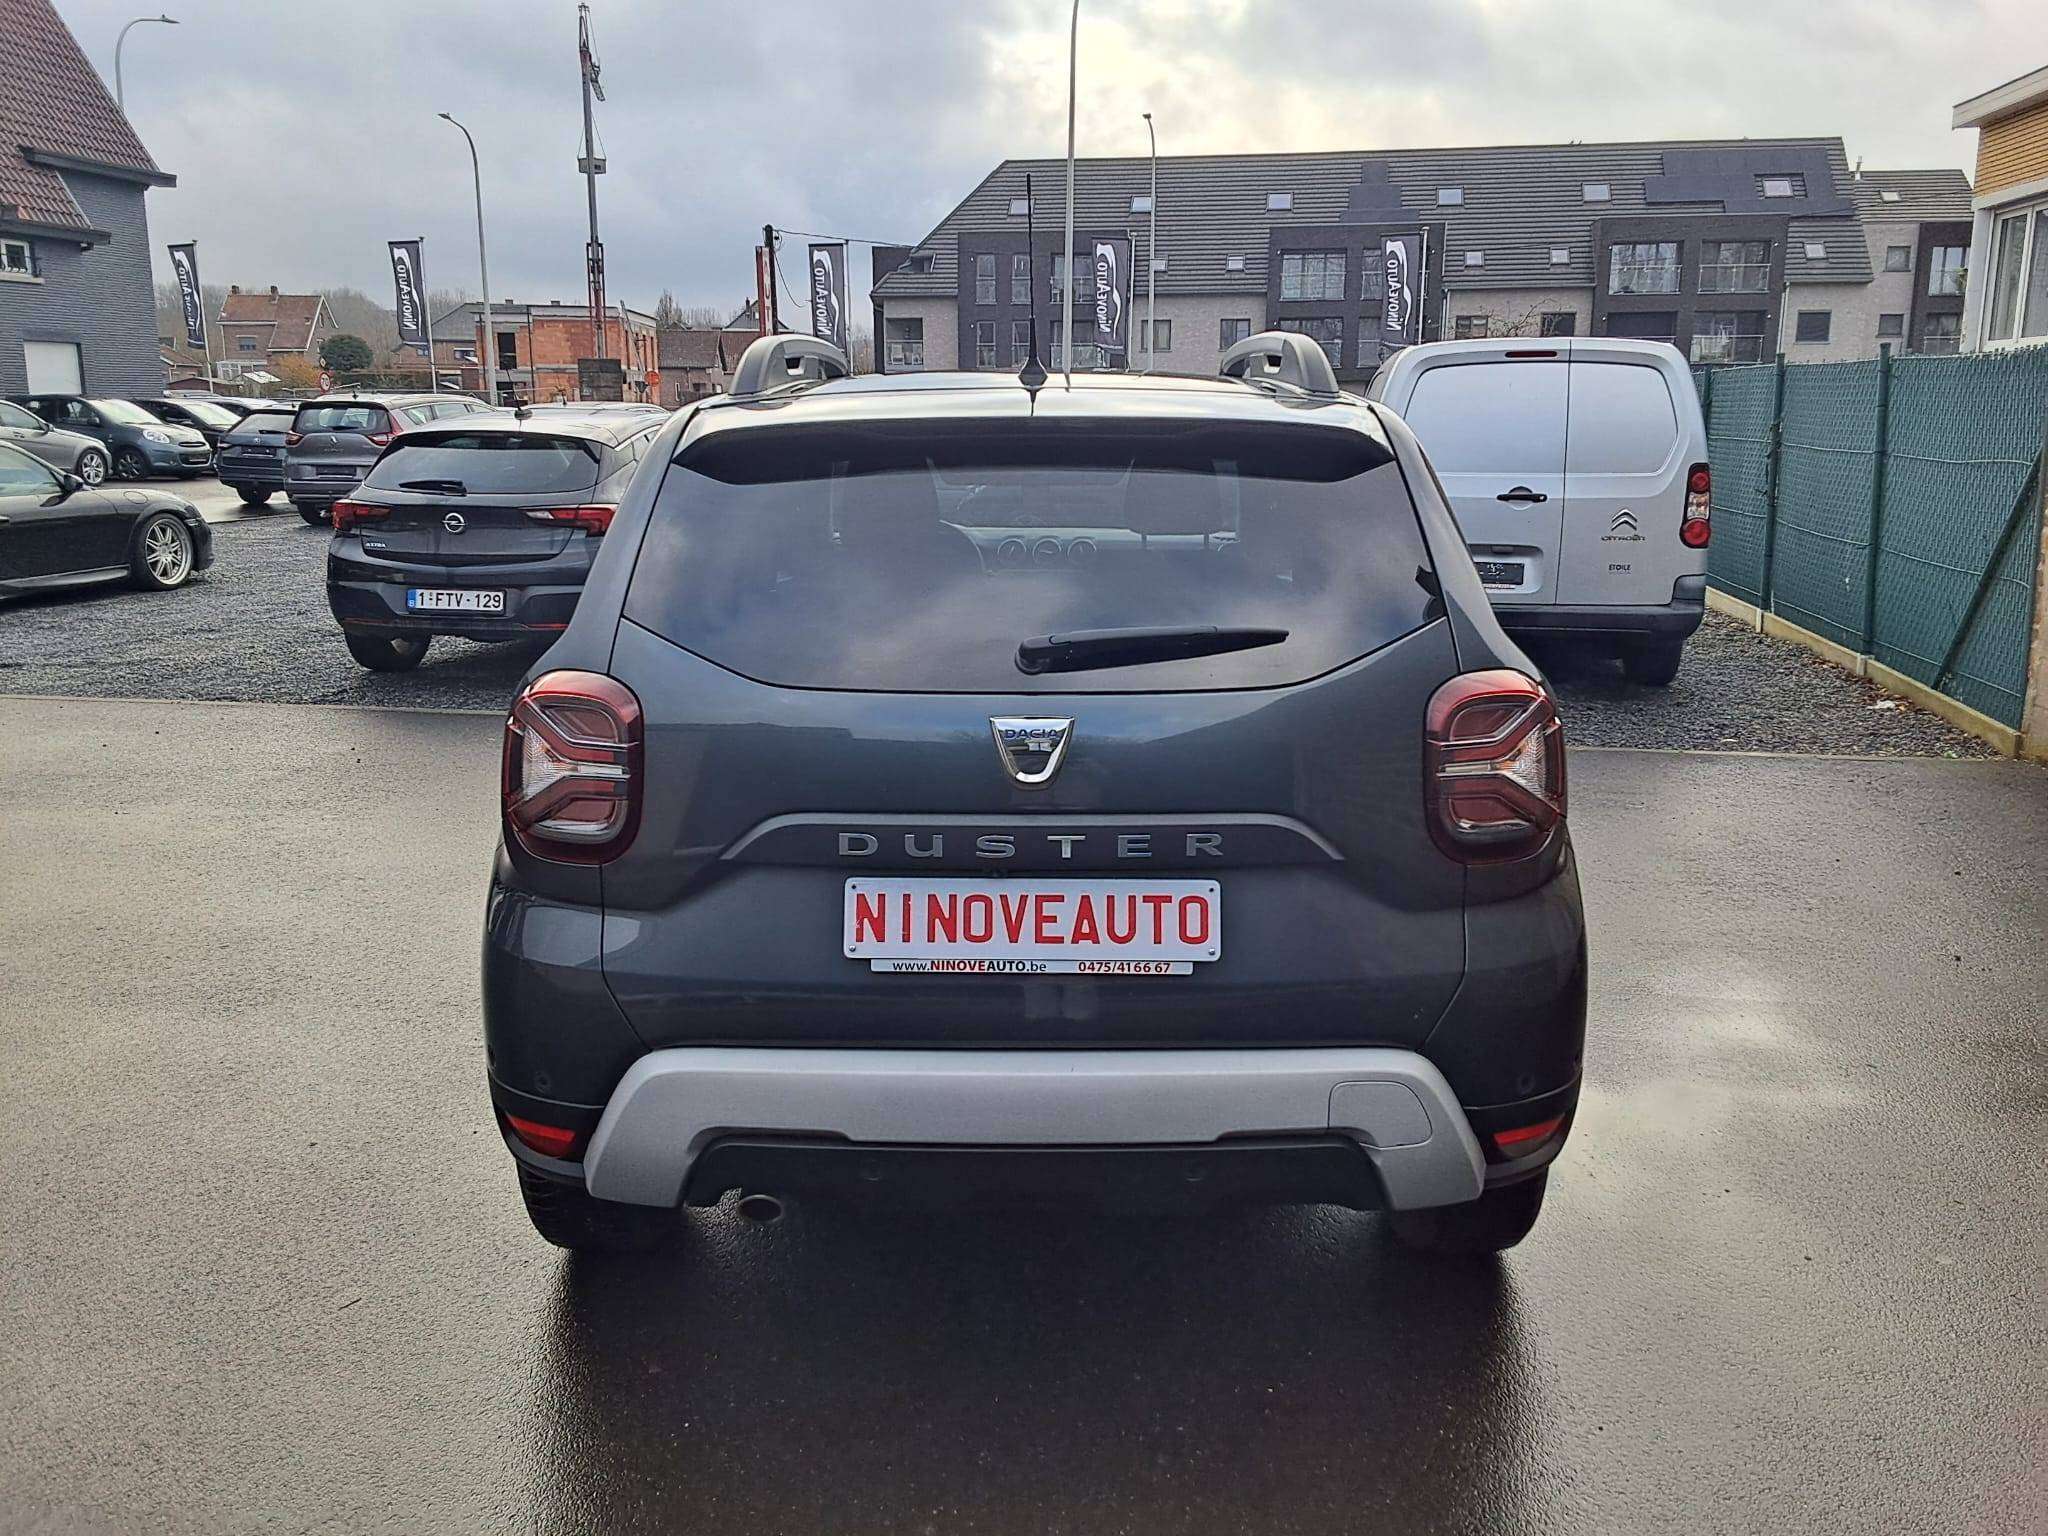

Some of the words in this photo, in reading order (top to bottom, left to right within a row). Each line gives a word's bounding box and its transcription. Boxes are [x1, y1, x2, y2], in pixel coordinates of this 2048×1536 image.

[1003, 728, 1059, 739] DACIA
[837, 832, 1224, 859] DUSTER
[855, 893, 1210, 945] NINOVEAUTO
[892, 960, 1047, 972] www.NINOVEAUTO.be
